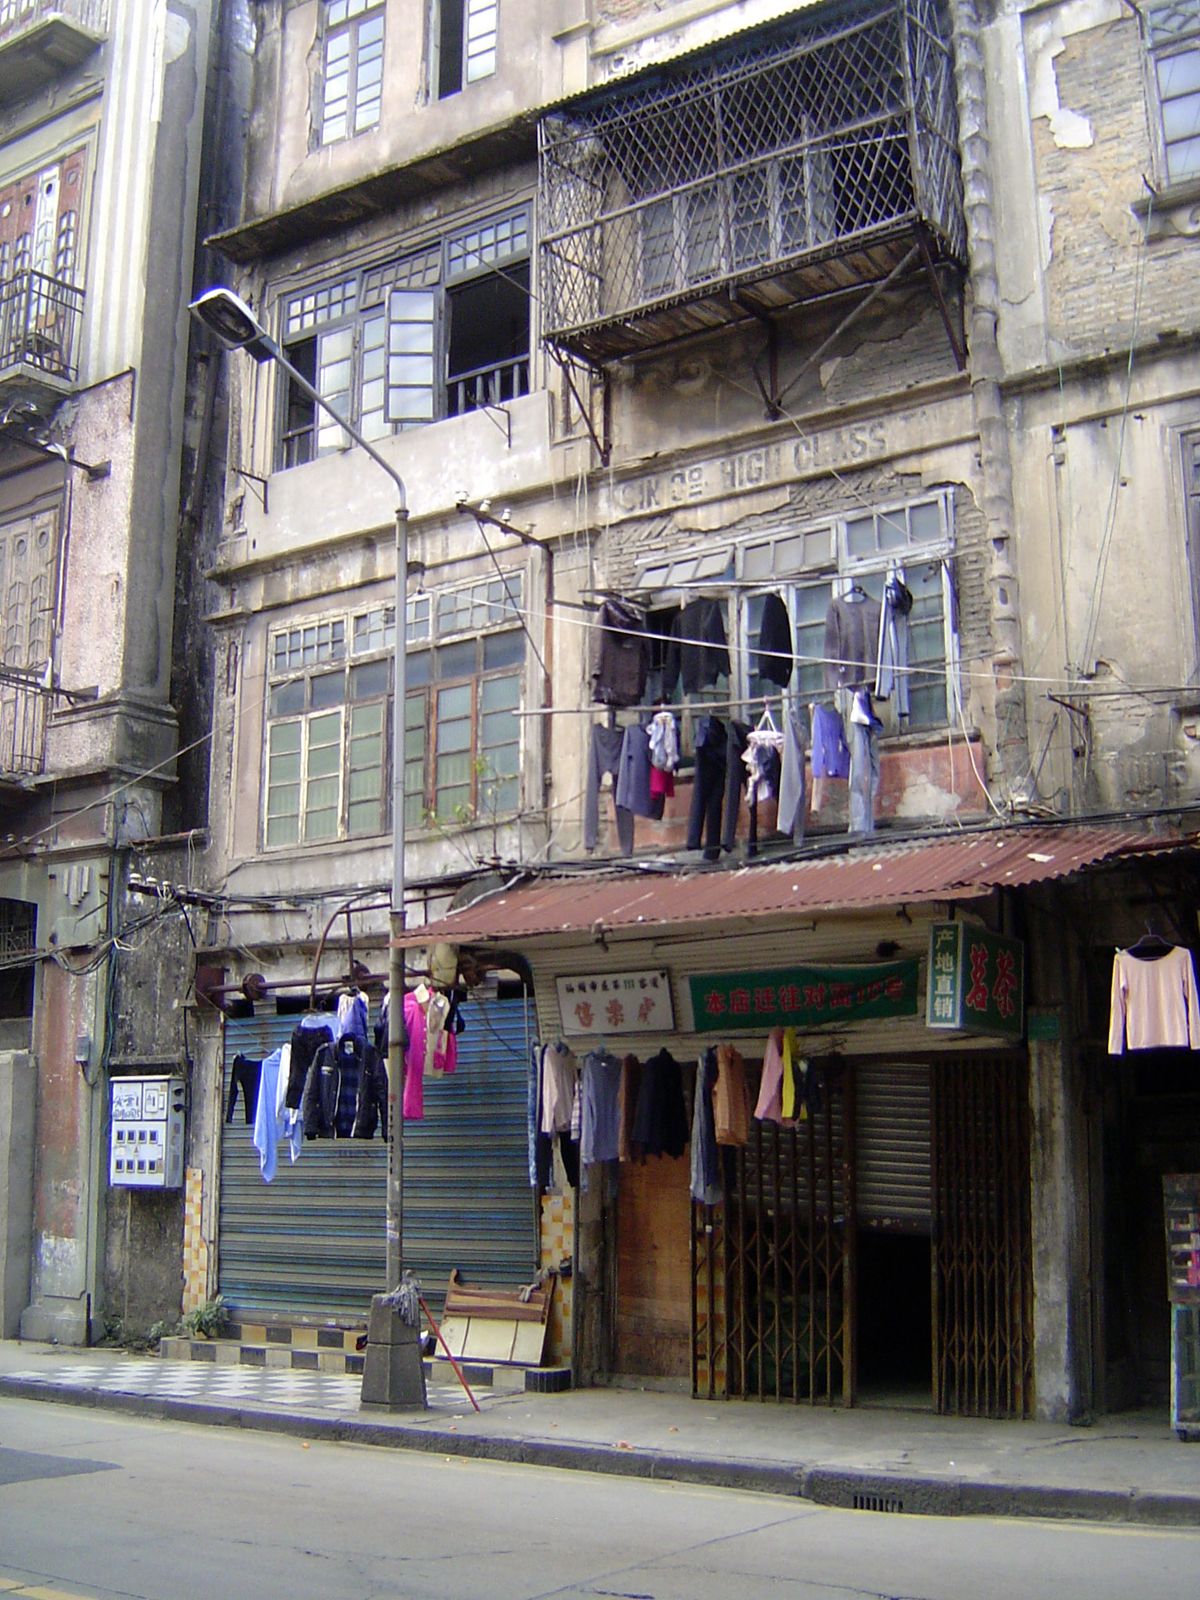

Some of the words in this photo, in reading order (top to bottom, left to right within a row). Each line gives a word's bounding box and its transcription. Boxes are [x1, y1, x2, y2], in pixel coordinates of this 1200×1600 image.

[794, 420, 887, 472] CLASS
[934, 929, 955, 1019] 产地直销
[965, 942, 1019, 1019] 茗茶
